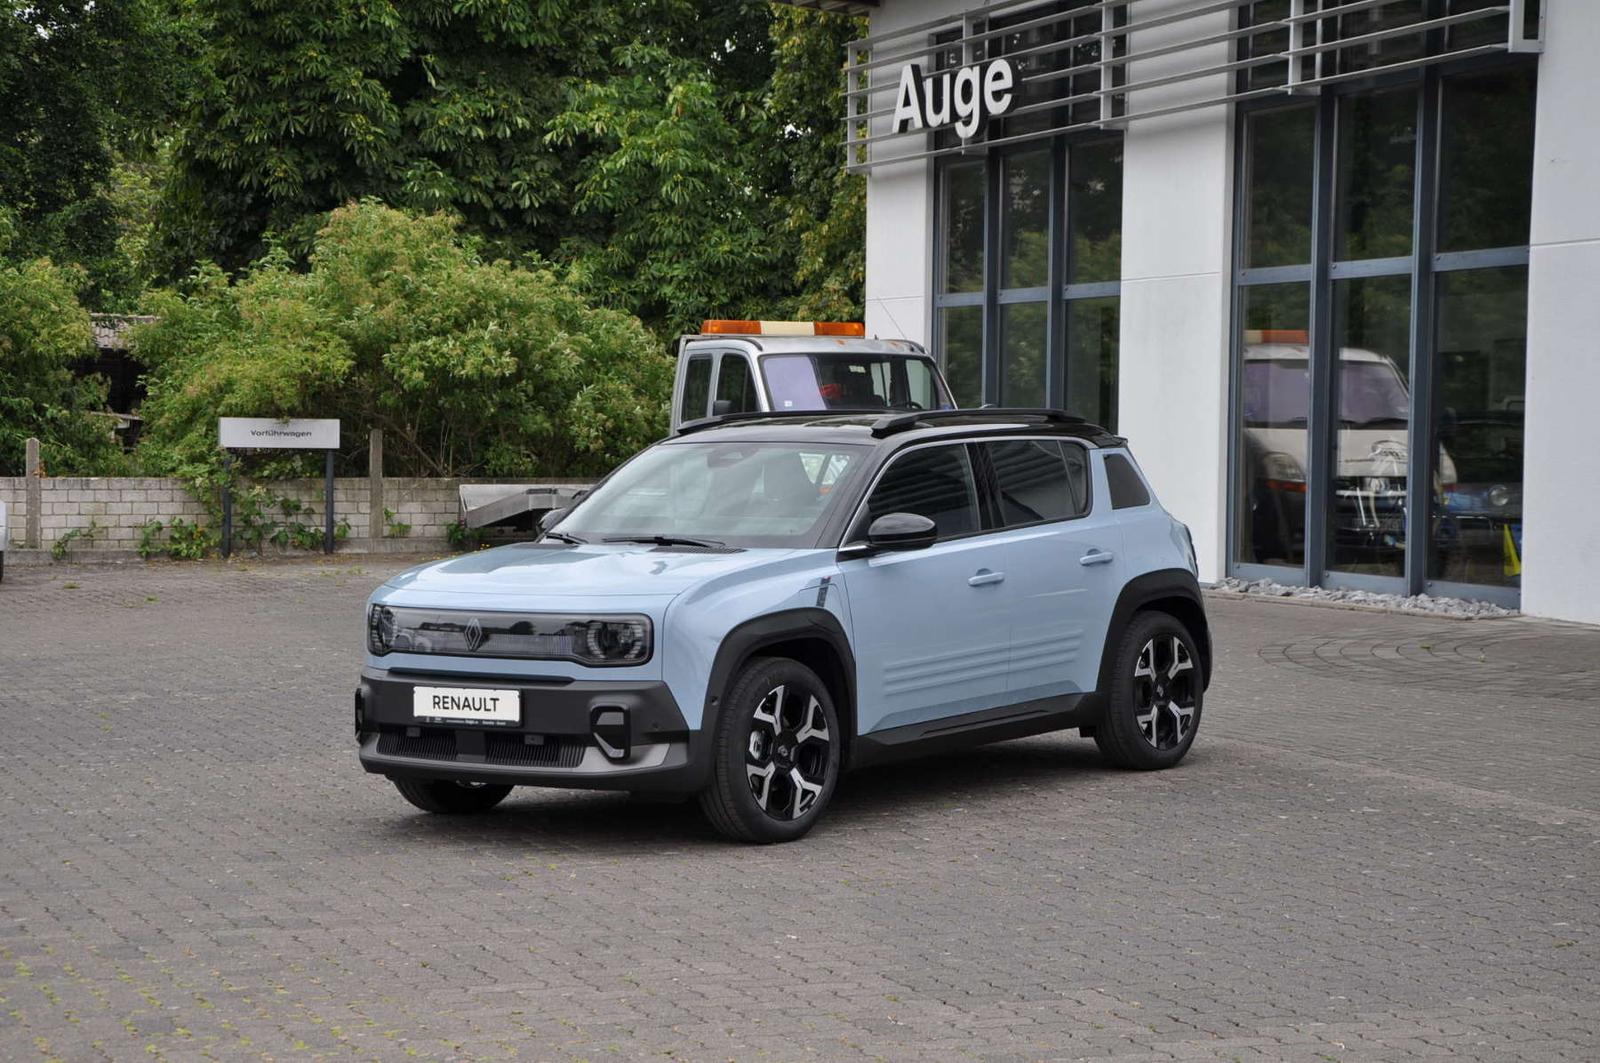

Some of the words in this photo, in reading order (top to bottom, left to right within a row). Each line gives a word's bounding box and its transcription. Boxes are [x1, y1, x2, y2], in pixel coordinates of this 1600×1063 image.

[892, 58, 1013, 139] Auge
[250, 429, 312, 438] Vorführwagen
[432, 695, 500, 712] RENAULT
